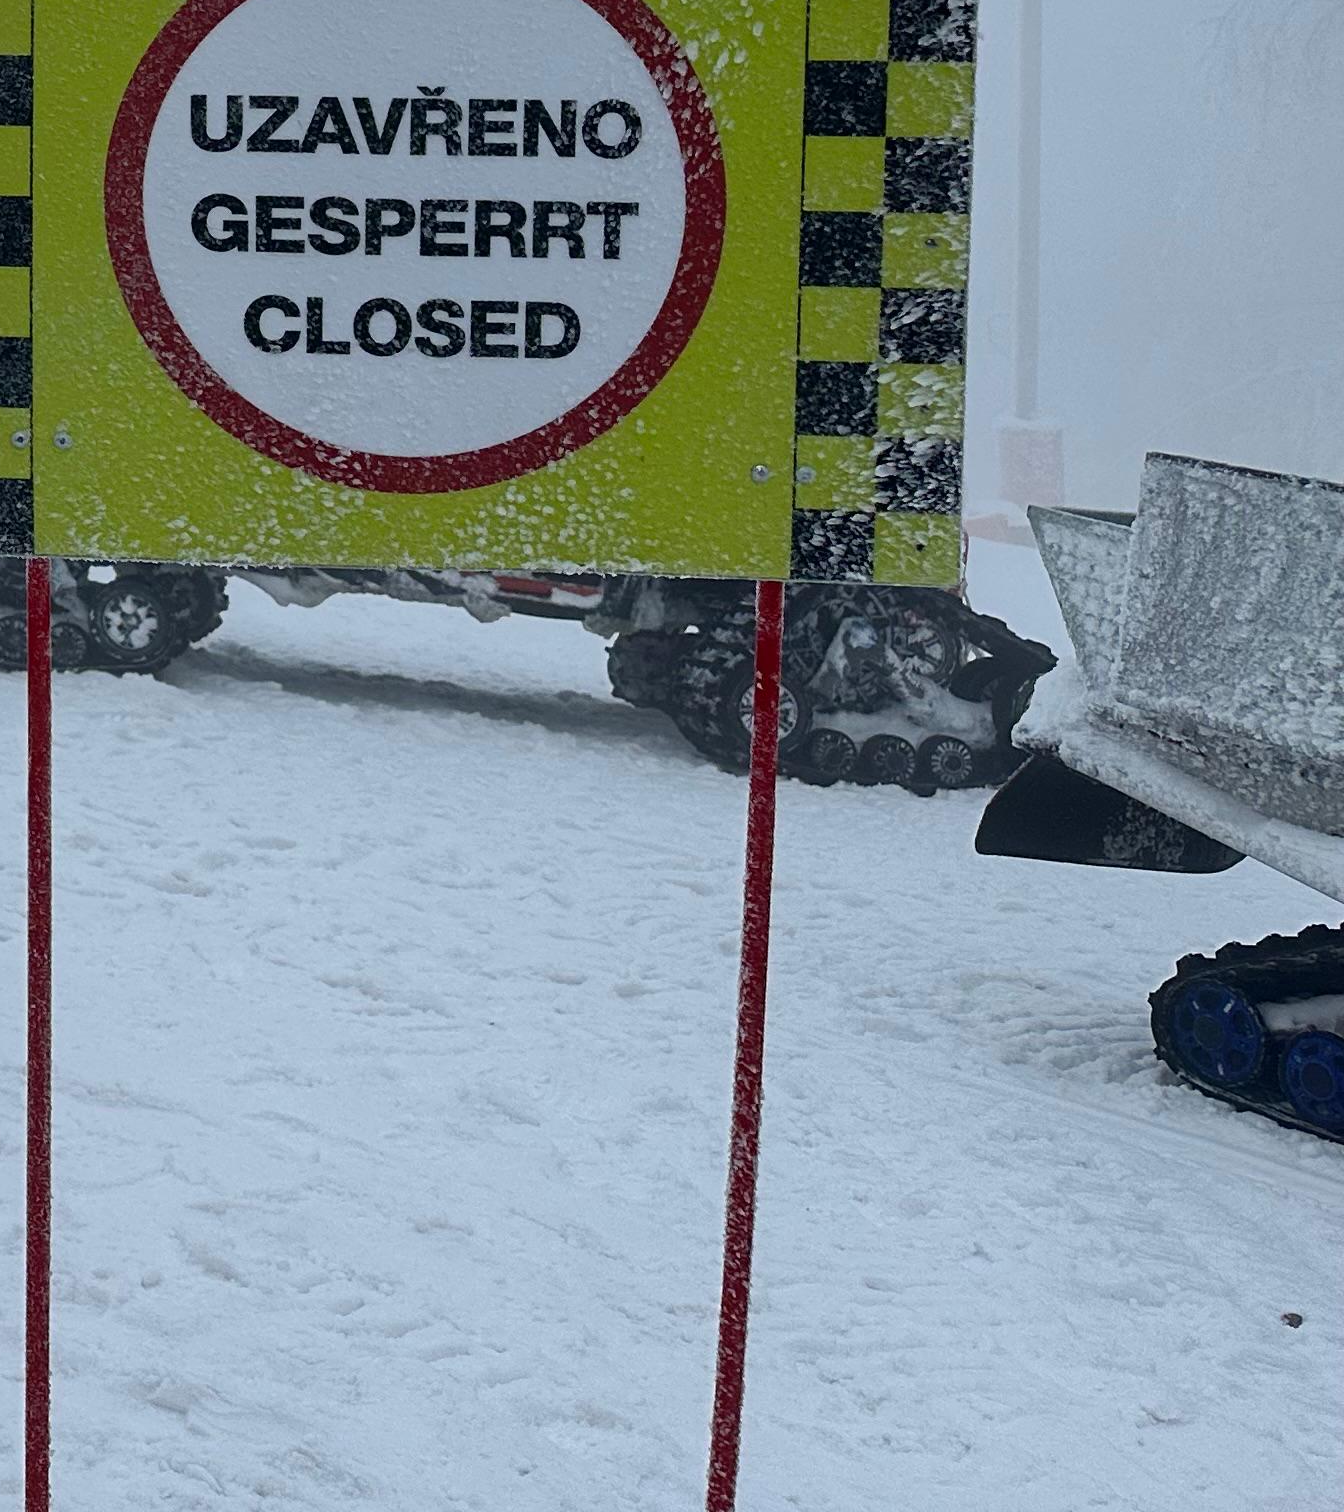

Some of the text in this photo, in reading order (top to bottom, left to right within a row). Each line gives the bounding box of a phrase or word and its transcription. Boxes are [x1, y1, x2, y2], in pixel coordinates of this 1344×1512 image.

[189, 85, 643, 159] UZAVŘENO
[190, 193, 640, 259] GESPERRT
[243, 294, 581, 359] CLOSED
